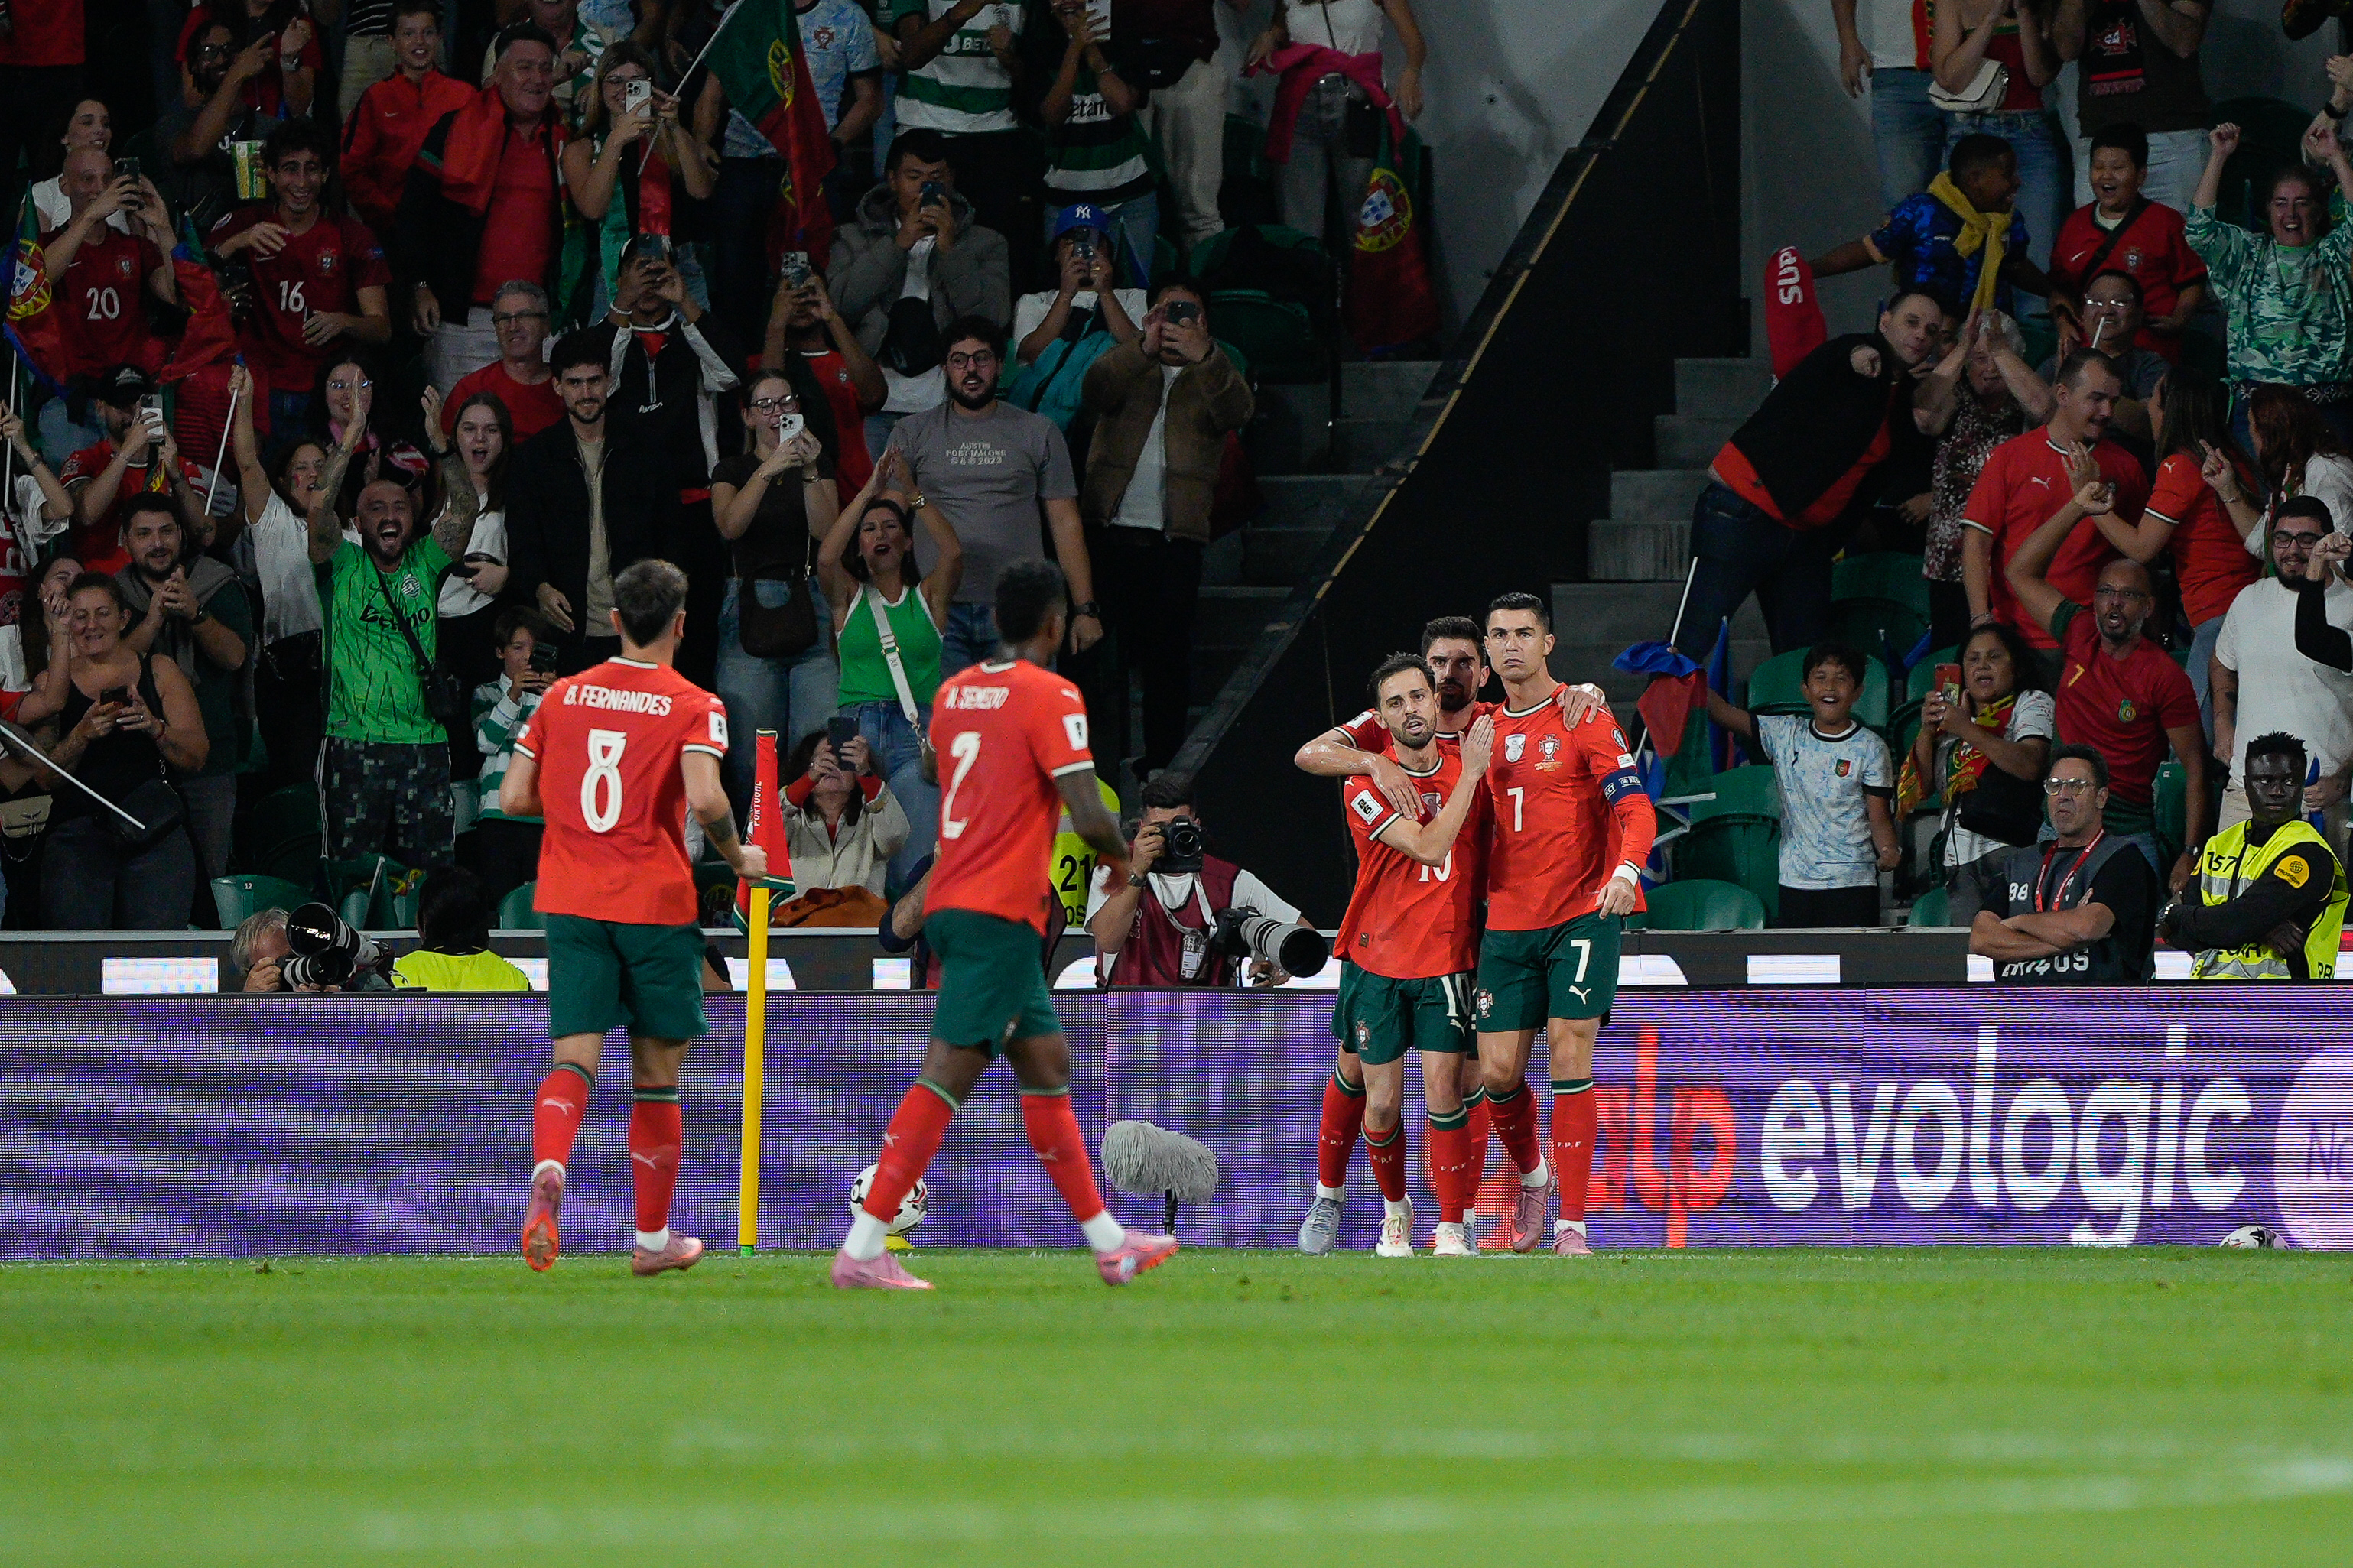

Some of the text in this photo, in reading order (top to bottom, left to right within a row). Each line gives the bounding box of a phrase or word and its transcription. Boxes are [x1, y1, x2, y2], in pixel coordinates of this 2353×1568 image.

[86, 287, 120, 320] 20
[279, 280, 304, 313] 16
[2067, 663, 2085, 688] 7
[580, 728, 627, 833] 8
[942, 731, 983, 839] 2
[753, 781, 762, 826] PORTUGAL
[1507, 787, 1524, 833] 7
[2208, 851, 2238, 873] 157
[2009, 882, 2029, 901] 98
[1571, 938, 1591, 982] 7
[1441, 972, 1471, 1018] 10
[1761, 1024, 2252, 1248] evologic
